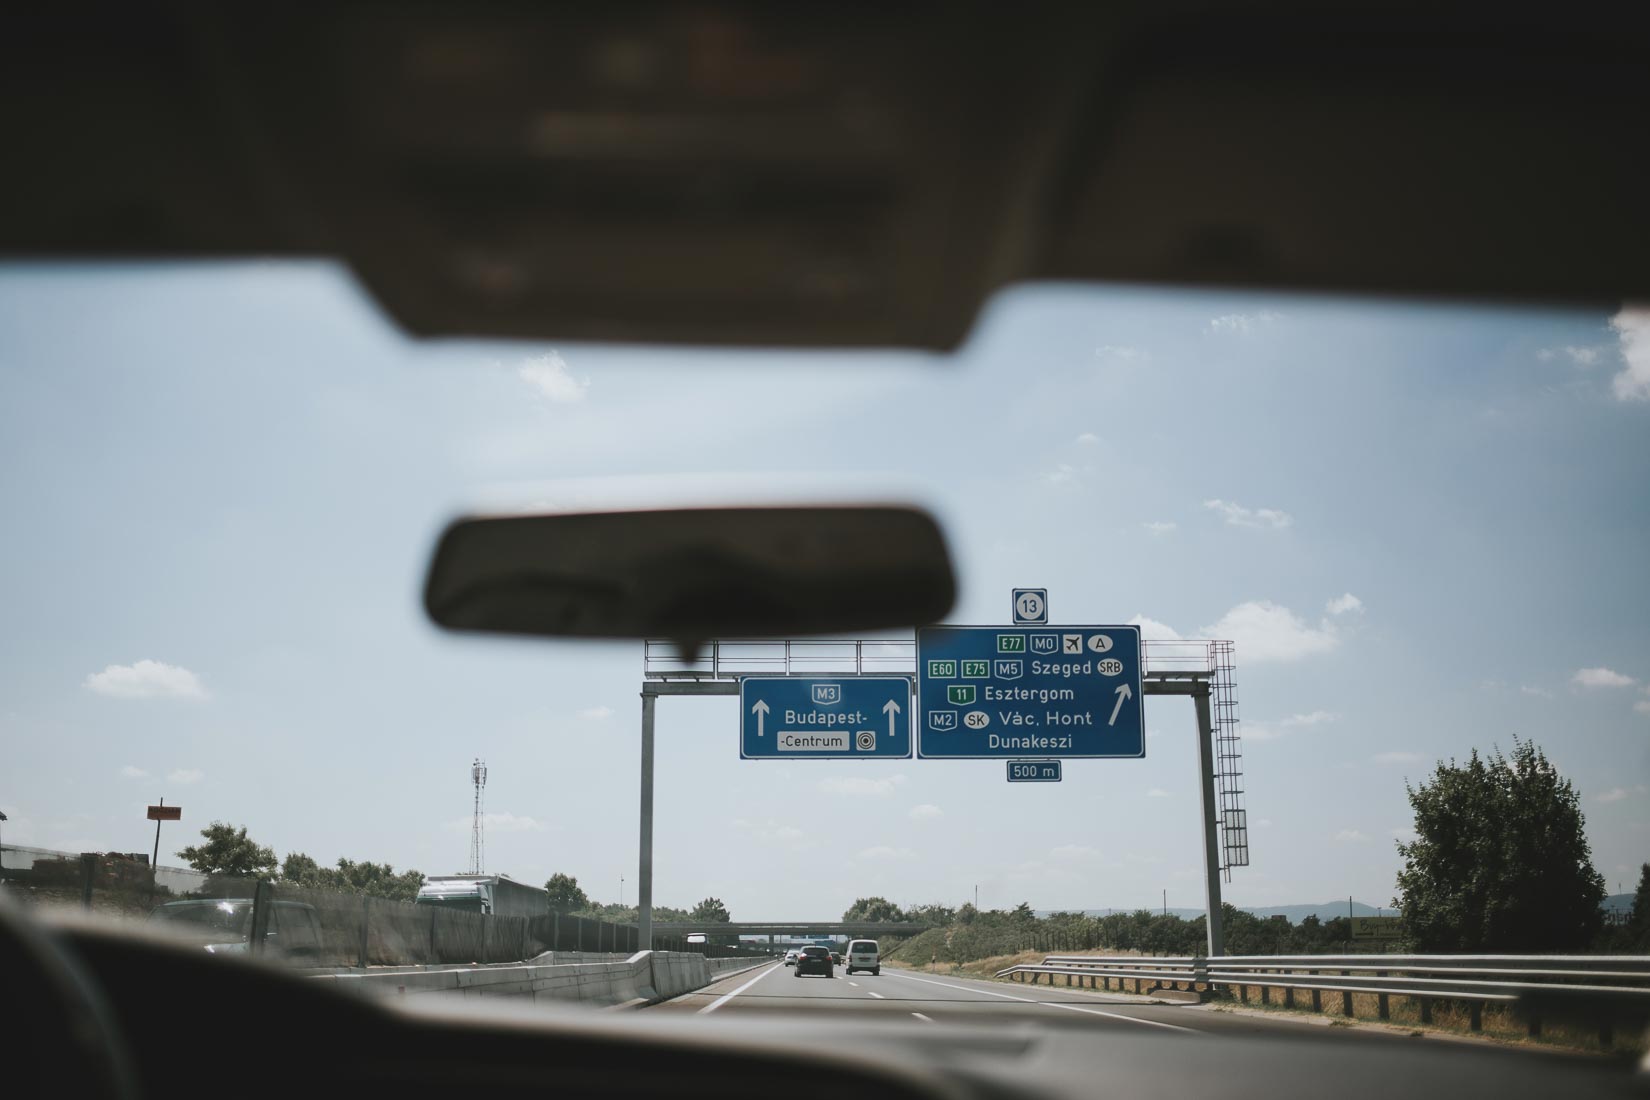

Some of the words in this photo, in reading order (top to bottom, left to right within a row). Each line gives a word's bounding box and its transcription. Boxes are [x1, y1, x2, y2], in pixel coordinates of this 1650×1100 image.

[1023, 599, 1037, 614] 13
[1002, 638, 1020, 650] E77
[1095, 638, 1106, 649] A
[933, 663, 952, 676] E60
[966, 663, 985, 676] E75
[1000, 663, 1018, 675] M5
[1032, 661, 1091, 678] Szeged
[1100, 662, 1121, 674] SRB
[817, 688, 835, 700] M3
[956, 688, 967, 700] 11
[985, 686, 1074, 703] Esztergom
[785, 710, 867, 727] Budapest-
[934, 714, 952, 726] M2
[968, 714, 985, 726] SK
[1046, 711, 1092, 726] Hont
[780, 736, 842, 746] -Centrum
[989, 734, 1072, 748] Dunakeszi
[1014, 766, 1037, 777] 500
[1043, 768, 1055, 776] m
